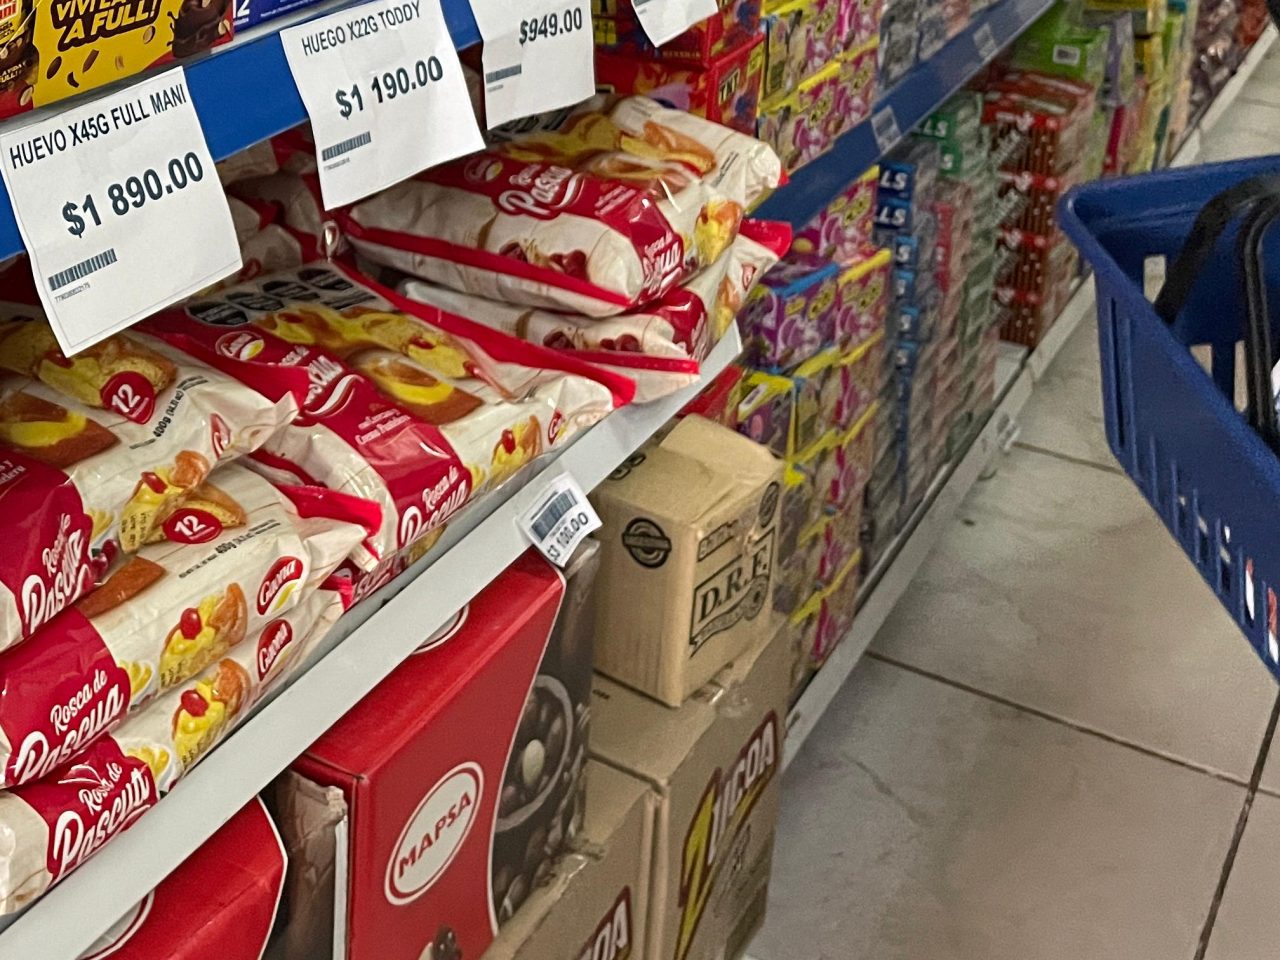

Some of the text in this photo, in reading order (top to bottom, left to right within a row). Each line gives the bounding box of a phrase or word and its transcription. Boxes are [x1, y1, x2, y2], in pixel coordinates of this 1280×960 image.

[65, 20, 86, 43] A
[301, 0, 422, 57] HUEGO X22G TODDY
[519, 7, 583, 46] $949.00
[335, 55, 444, 121] $1 190.00
[9, 83, 188, 170] HUEVO X45G FULL MANI
[61, 151, 204, 239] $1 890.00
[111, 383, 141, 412] 12
[173, 514, 207, 540] 12
[14, 683, 124, 786] Pascua
[50, 668, 108, 736] Rosca de
[51, 768, 150, 872] Pascua
[398, 791, 473, 880] MAPSA
